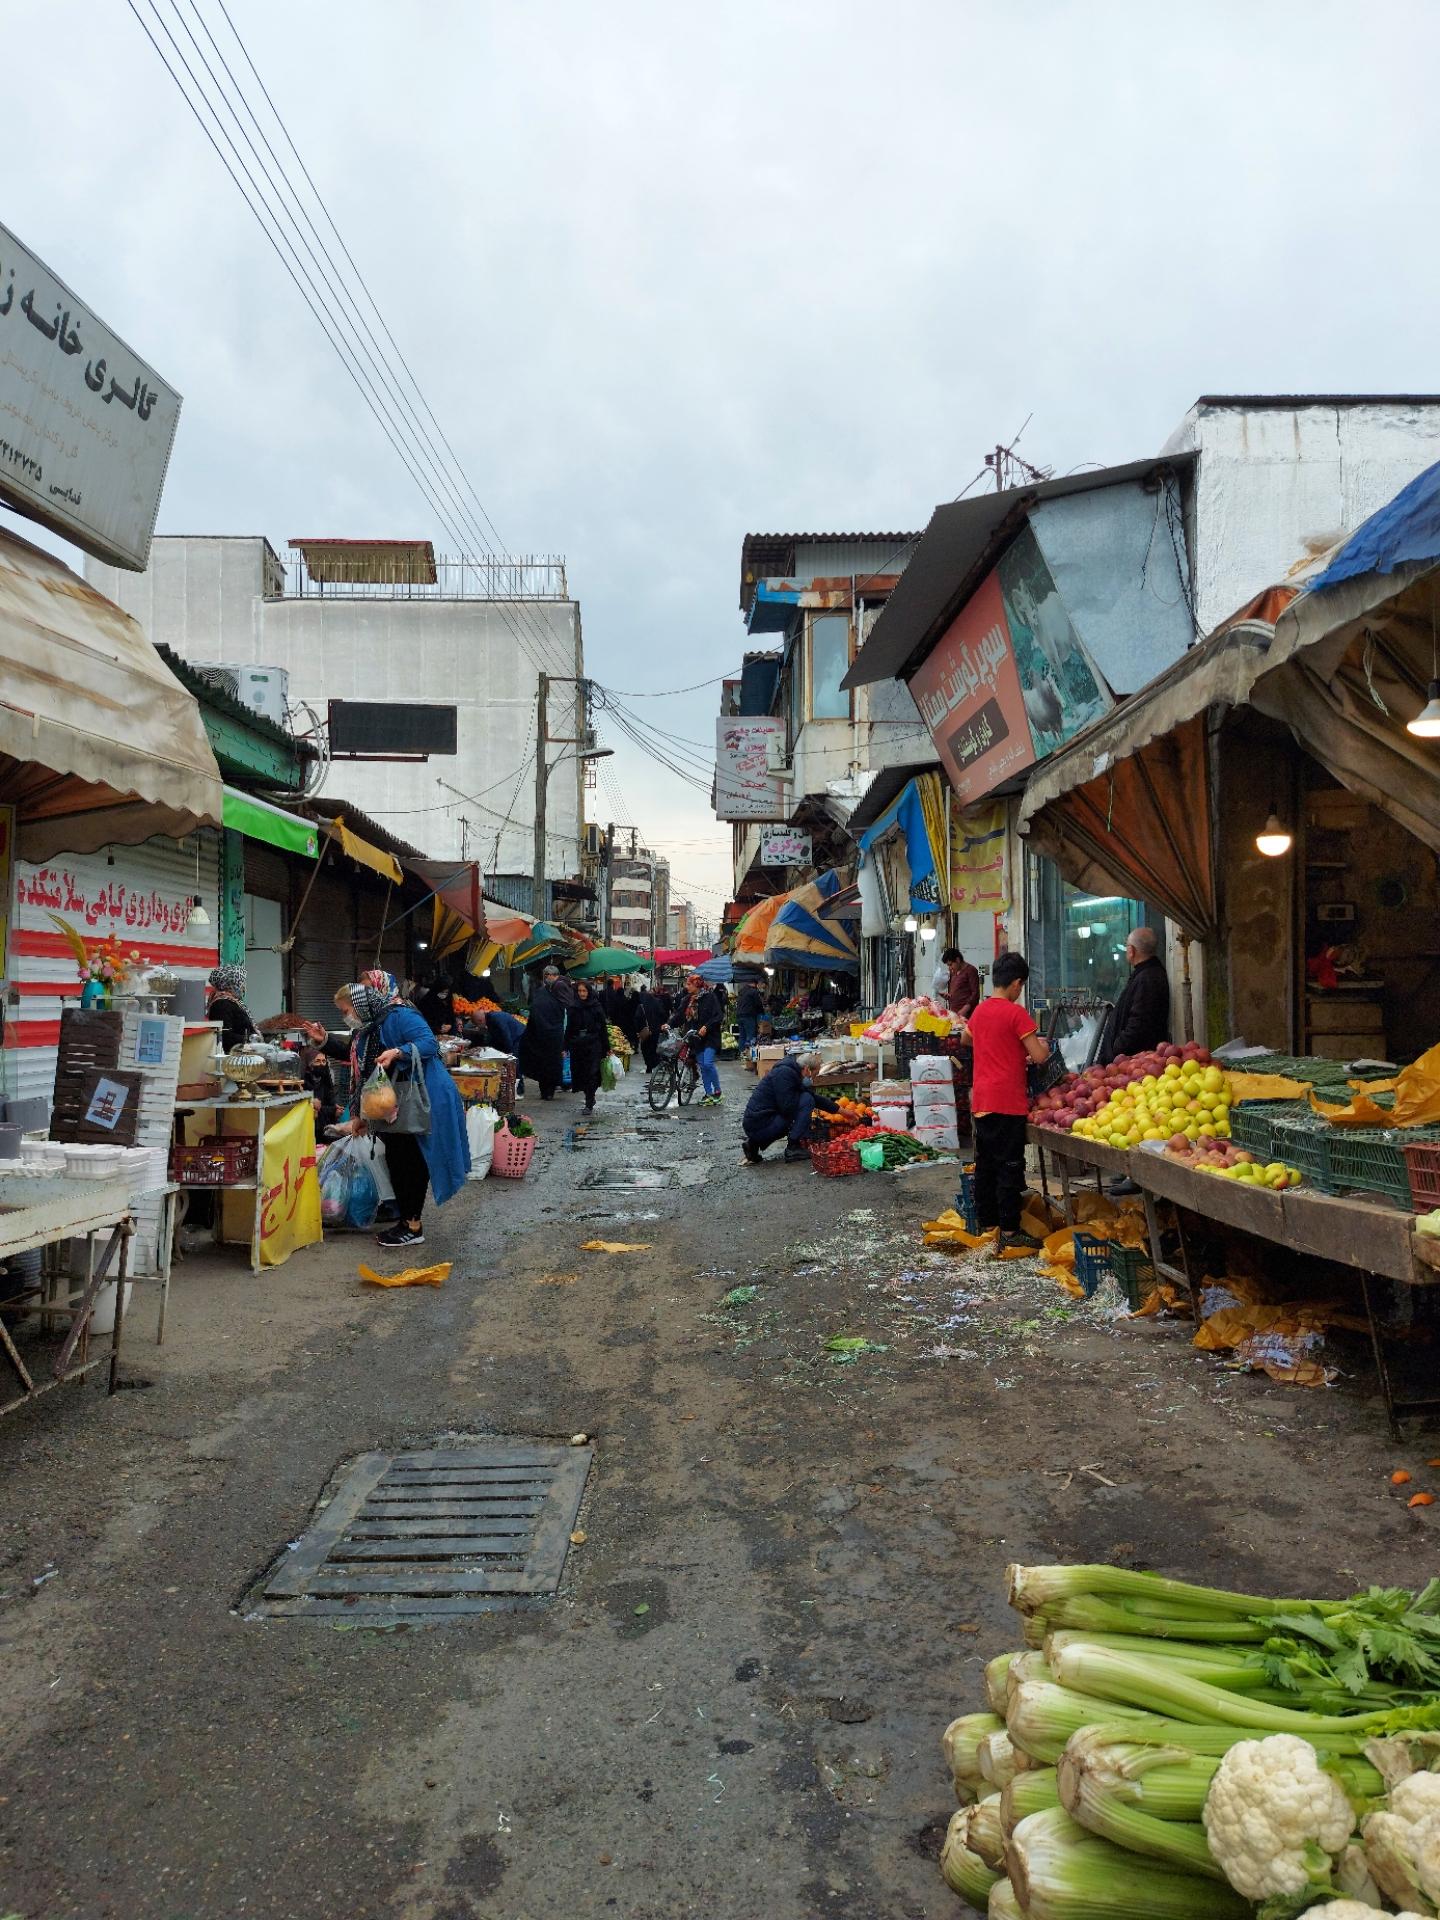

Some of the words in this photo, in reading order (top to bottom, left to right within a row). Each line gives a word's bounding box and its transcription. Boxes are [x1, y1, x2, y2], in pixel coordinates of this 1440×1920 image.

[20, 288, 84, 356] خانه
[85, 358, 159, 422] گالری
[768, 837, 803, 853] مرکزی
[951, 852, 1004, 872] قیم
[261, 1154, 317, 1241] حراج
